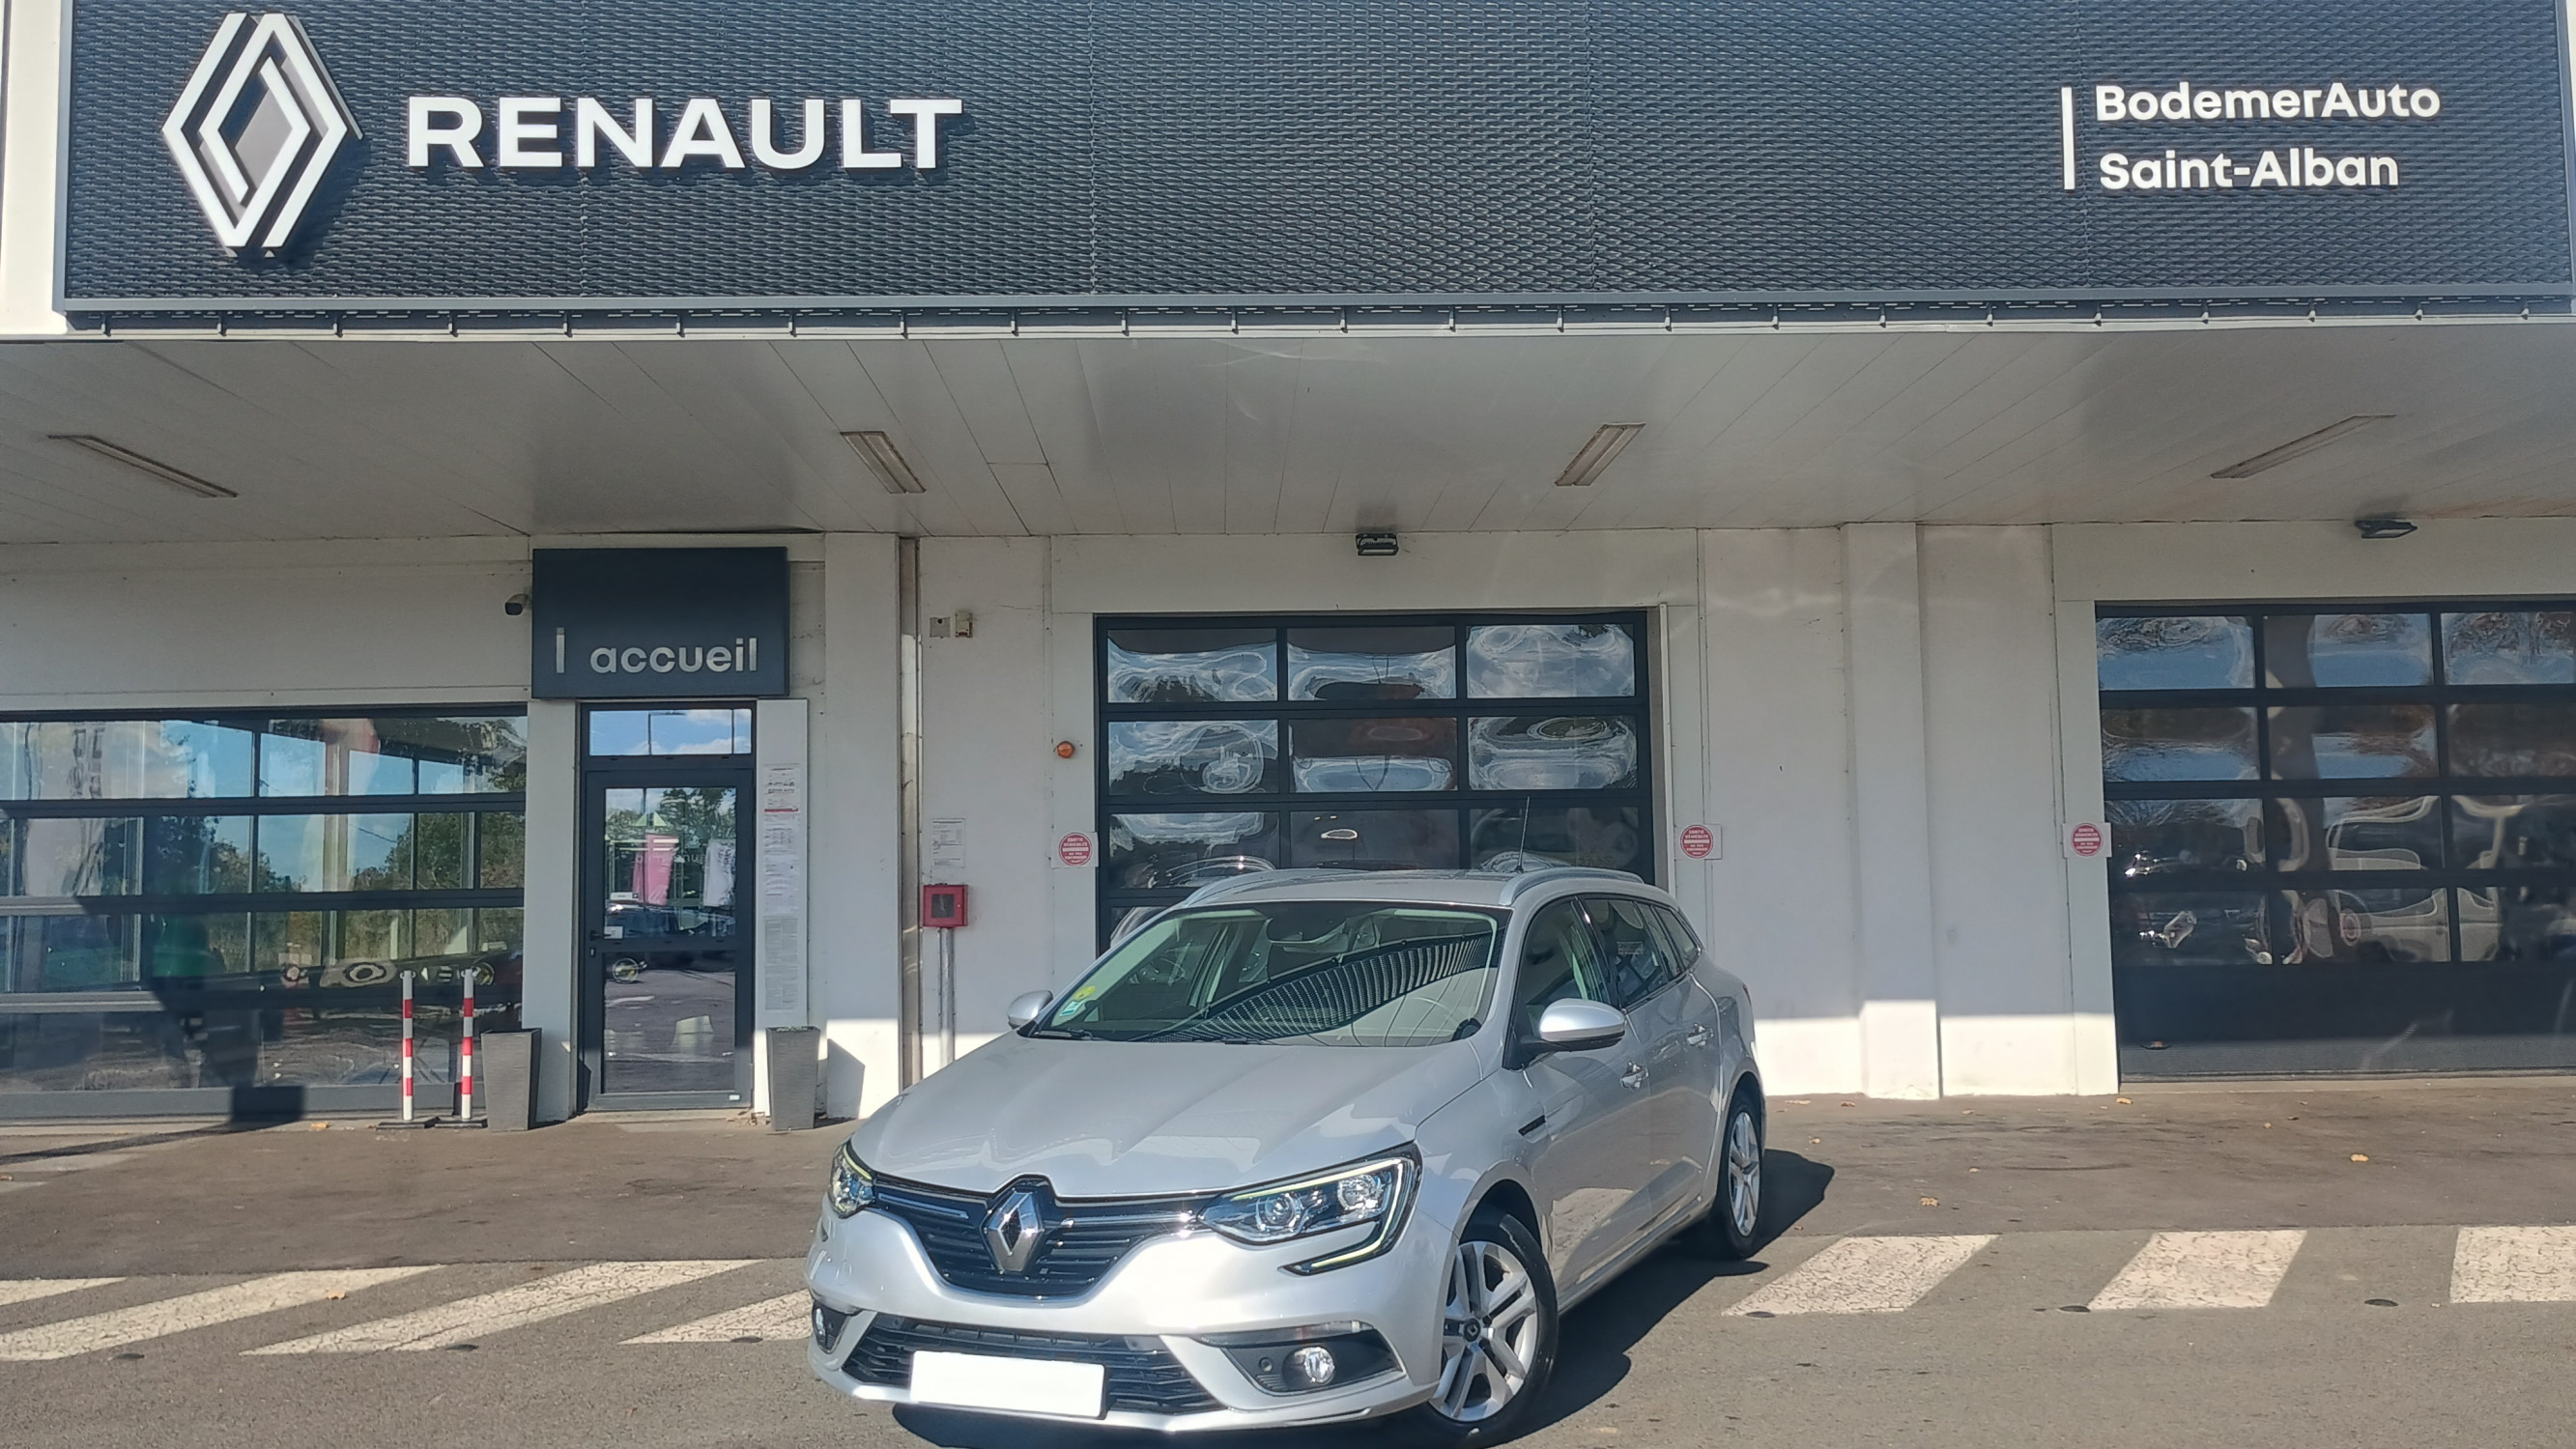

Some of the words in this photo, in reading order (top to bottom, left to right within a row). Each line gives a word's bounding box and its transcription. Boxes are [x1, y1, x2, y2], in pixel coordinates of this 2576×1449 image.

[2095, 80, 2442, 122] BodemerAuto
[407, 95, 963, 170] RENAULT
[2099, 147, 2400, 190] Saint-Alban
[589, 637, 758, 674] accueil
